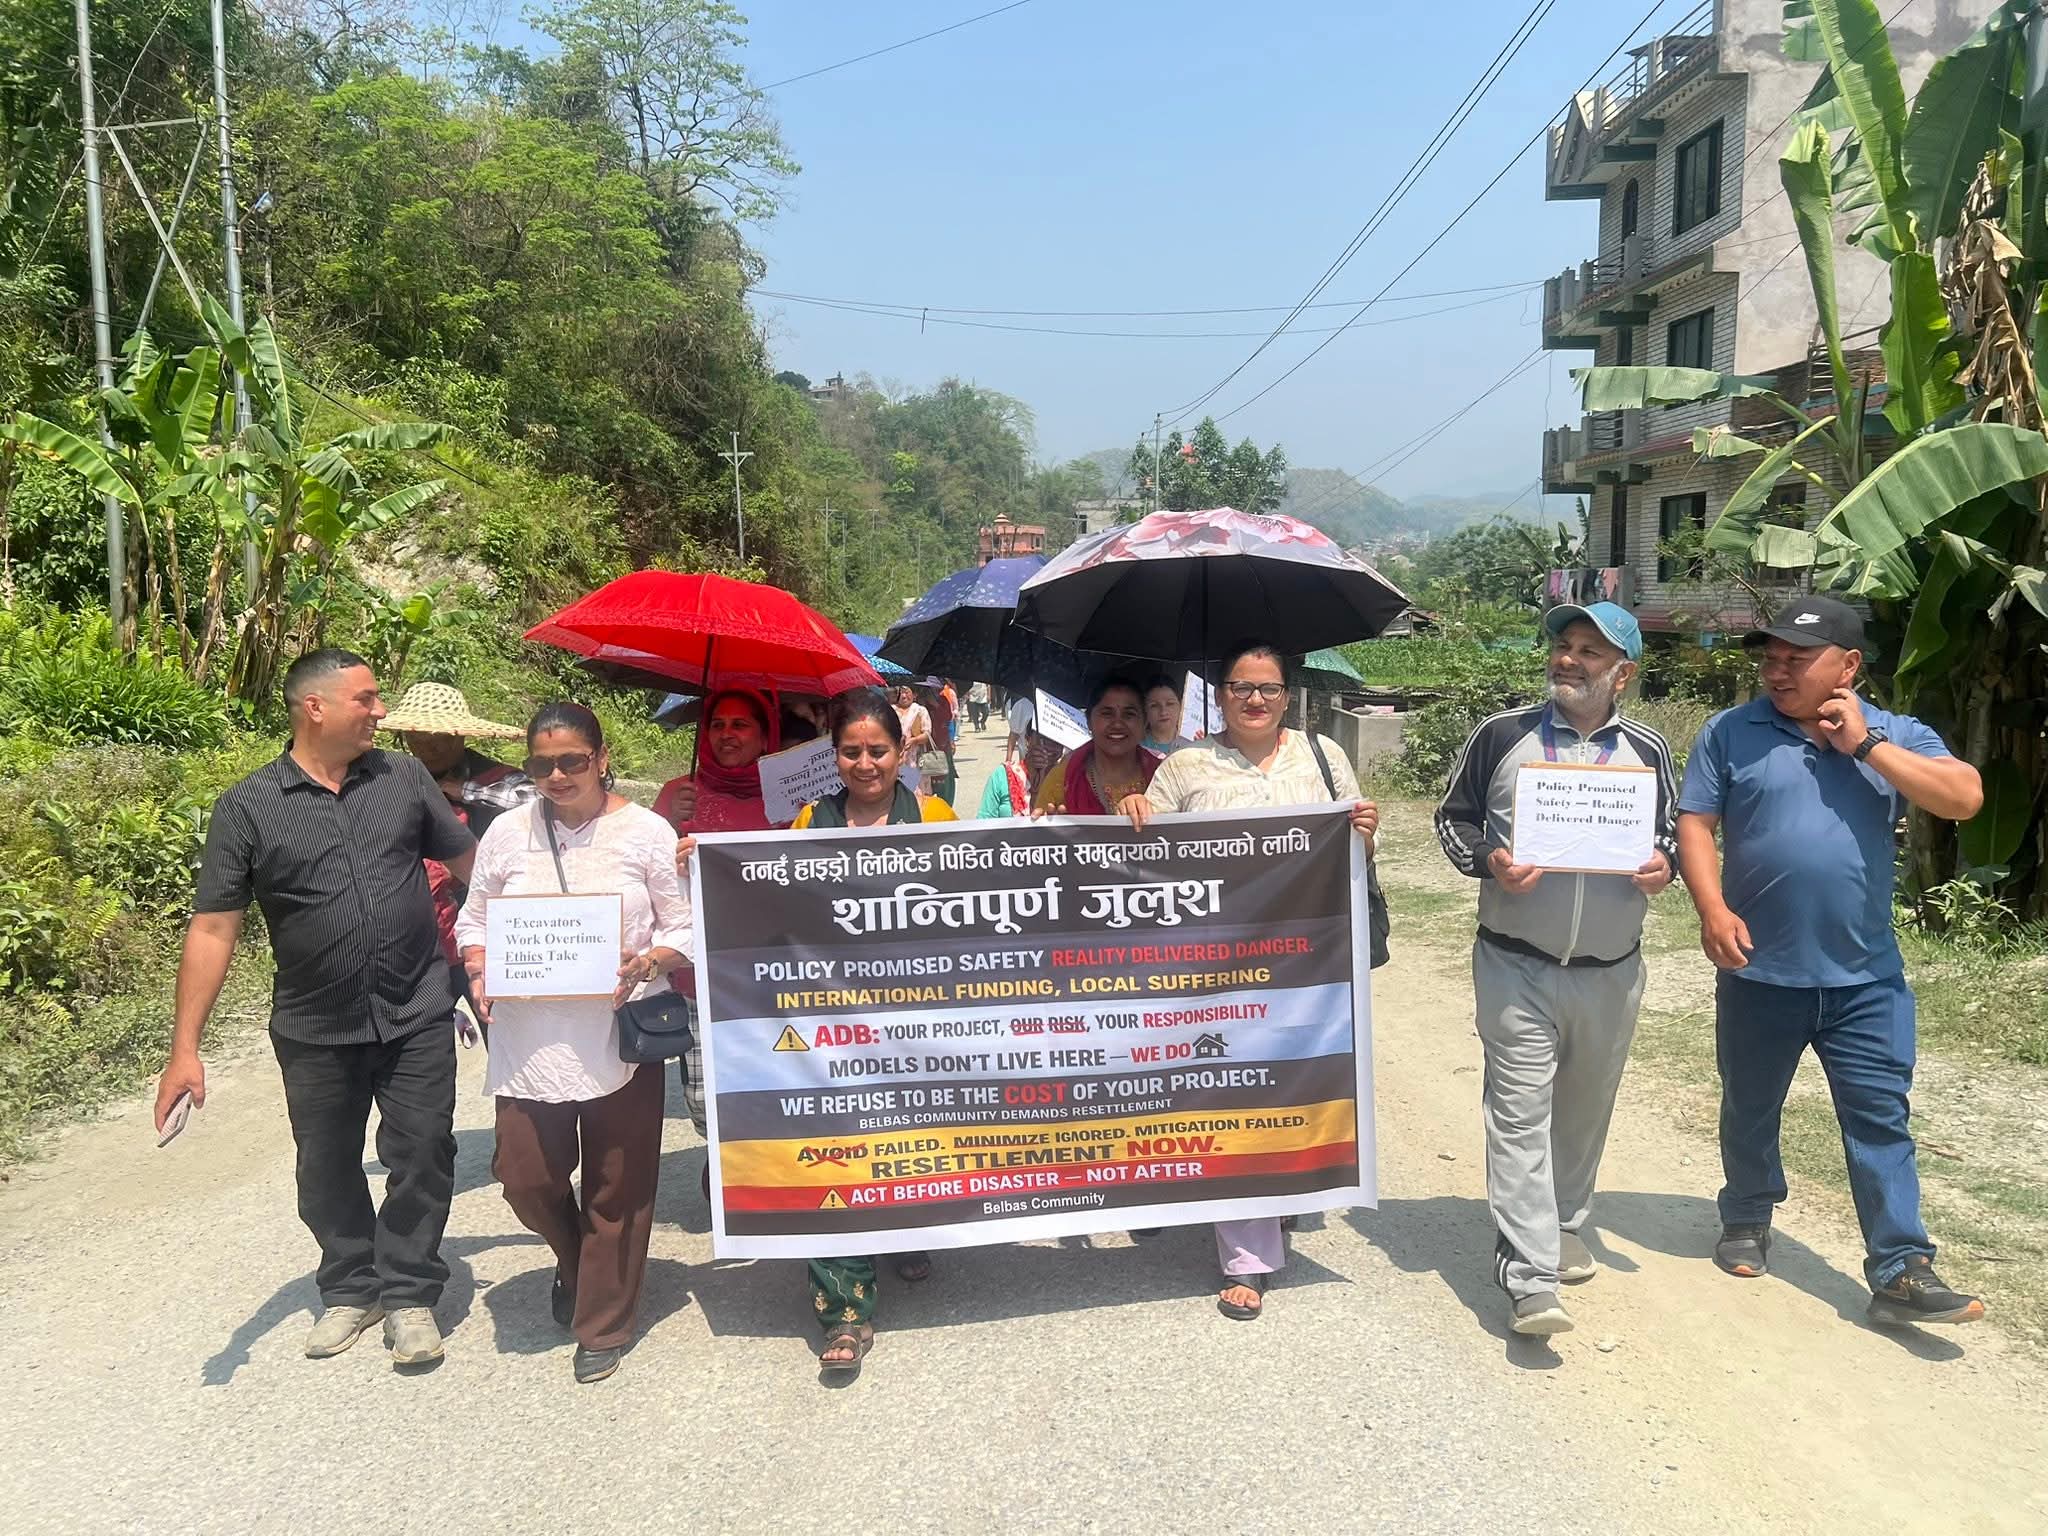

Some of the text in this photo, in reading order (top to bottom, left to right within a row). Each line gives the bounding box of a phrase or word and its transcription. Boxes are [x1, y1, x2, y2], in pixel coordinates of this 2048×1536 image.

[1536, 798, 1571, 809] Safety
[1592, 800, 1635, 812] Reality
[1537, 781, 1637, 794] Policy Promised
[1536, 813, 1642, 827] Delivered Danger
[856, 847, 933, 877] लिमिटेड
[939, 844, 993, 872] पिडित
[1000, 841, 1067, 866] बेलबास
[1074, 836, 1170, 868] समुदायको
[1177, 832, 1255, 858] न्यायको
[1262, 827, 1310, 854] लागि
[506, 917, 582, 929] “Excavators
[832, 877, 1224, 935] शान्तिपूर्ण जुलुश
[505, 932, 607, 945] Work Overtime.
[505, 950, 578, 964] Ethics Take
[505, 967, 551, 979] Leave.”
[754, 937, 1314, 982] POLICY PROMISED SAFETY REALITY DELIVERED DANGER.
[776, 967, 1271, 1009] INTERNATIONAL FUNDING, LOCAL SUFFERING
[814, 1004, 1268, 1048] ADB: YOUR PROJECT, OUR RISK, YOUR RESPONSIBILITY
[829, 1056, 918, 1078] MODELS
[925, 1053, 990, 1073] DON’T
[997, 1051, 1042, 1070] LIVE
[1050, 1049, 1106, 1068] HERE
[1131, 1045, 1162, 1063] WE
[1165, 1043, 1191, 1060] DO
[780, 1067, 1276, 1116] WE REFUSE TO BE THE COST OF YOUR PROJECT.
[859, 1099, 1172, 1129] BELBAS COMMUNITY DEMANDS RESETTLEMENT
[874, 1138, 945, 1156] FAILED.
[953, 1133, 1049, 1148] MINIMIZE
[1055, 1127, 1131, 1143] IGNORED.
[1135, 1119, 1240, 1136] MITIGATION
[1245, 1115, 1309, 1130] FAILED.
[871, 1135, 1223, 1179] RESETTLEMENT NOW.
[850, 1186, 887, 1204] ACT
[893, 1181, 963, 1200] BEFORE
[969, 1174, 1059, 1194] DISASTER
[1086, 1166, 1128, 1182] NOT
[1134, 1162, 1203, 1179] AFTER
[983, 1191, 1105, 1215] Belbas Community
